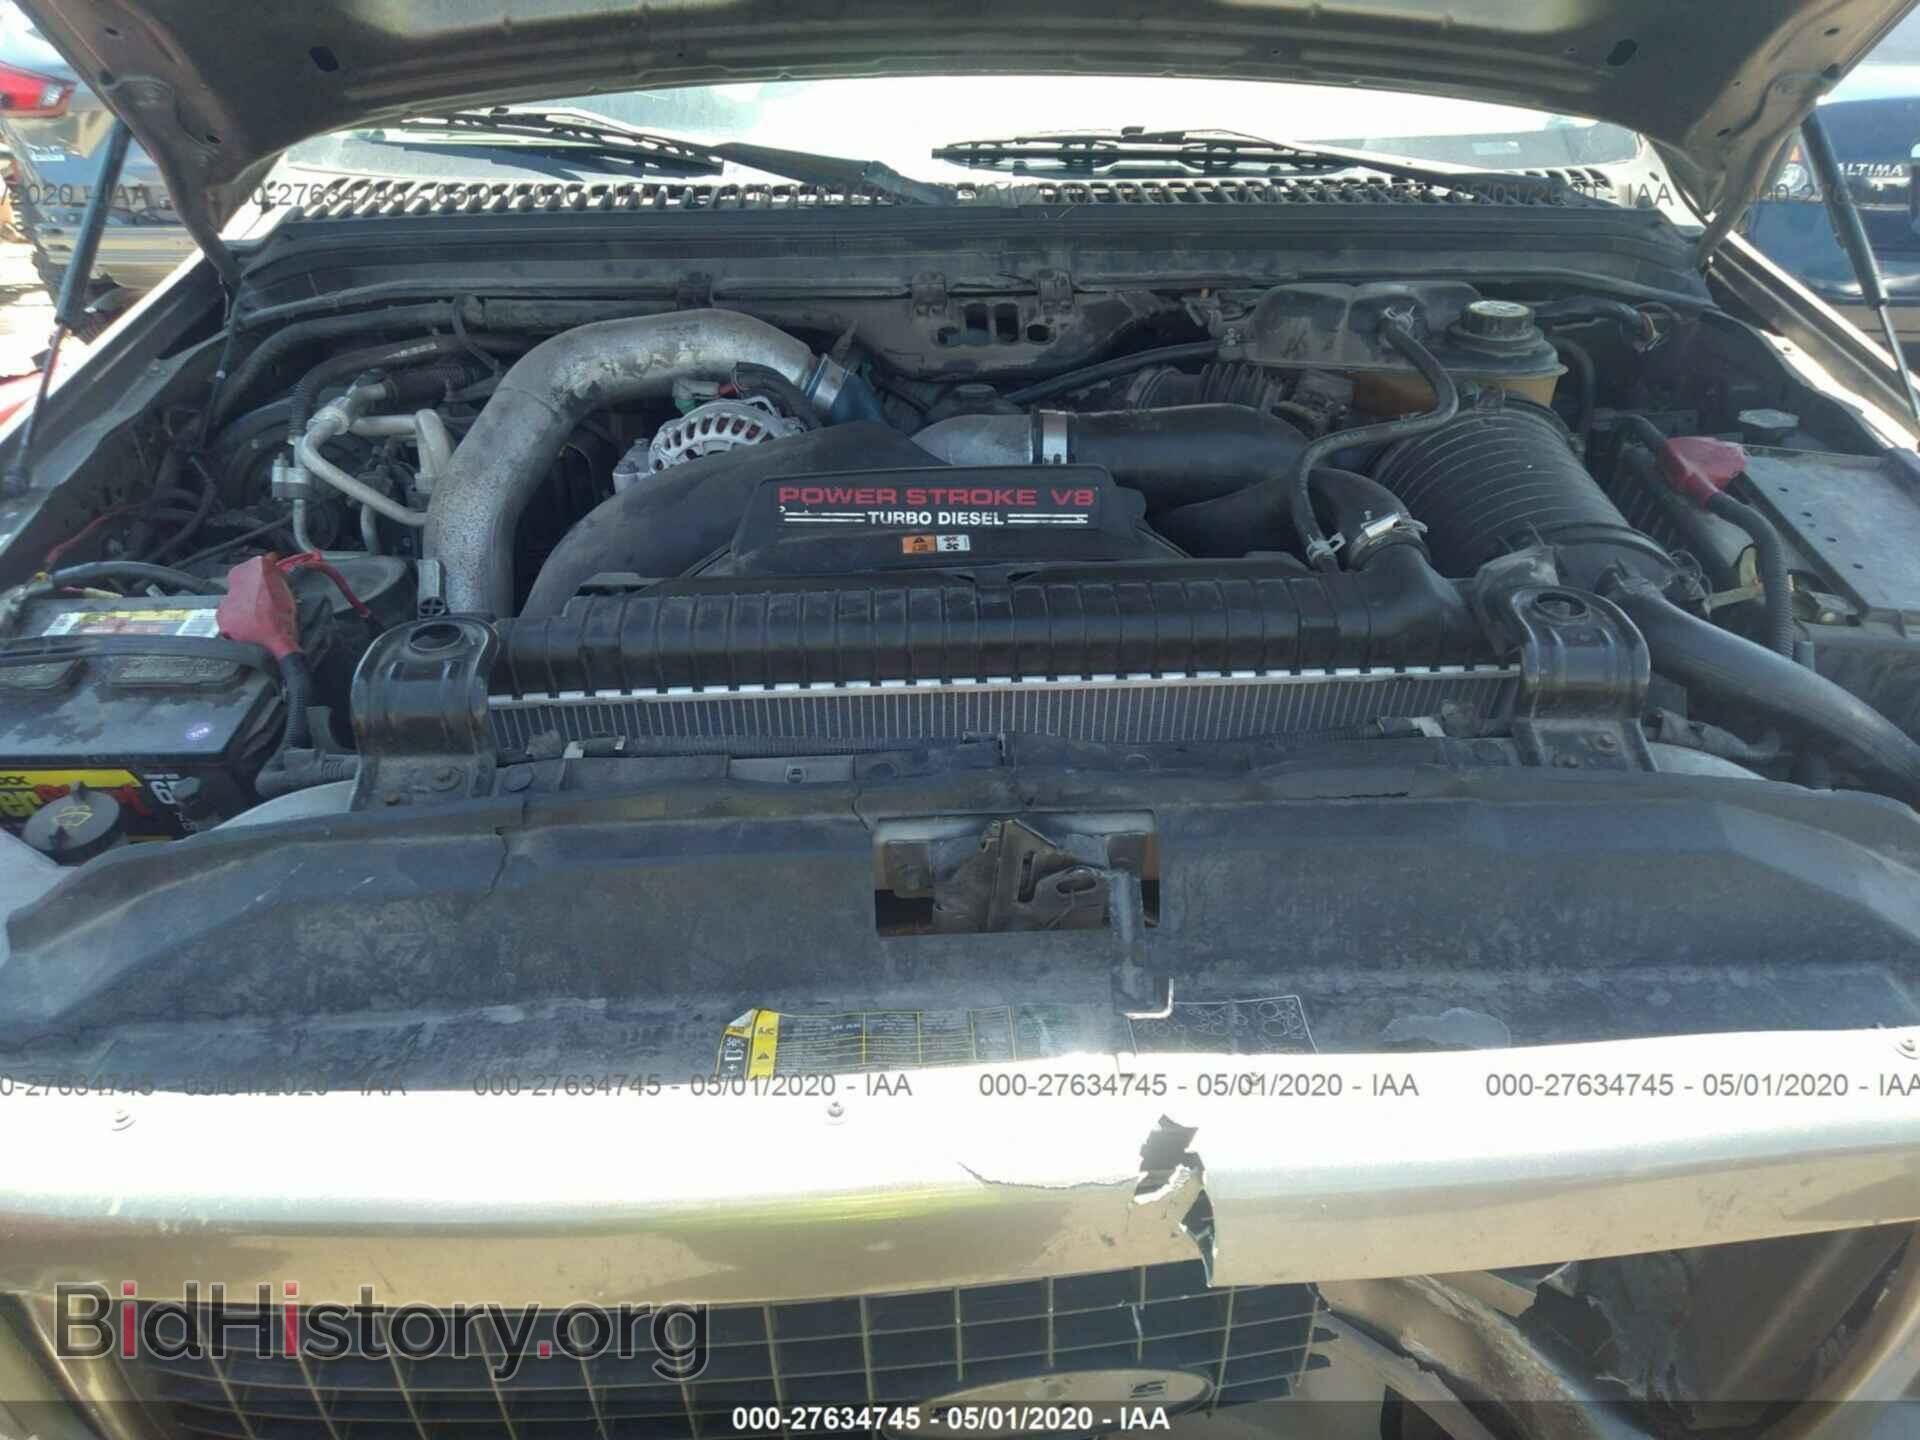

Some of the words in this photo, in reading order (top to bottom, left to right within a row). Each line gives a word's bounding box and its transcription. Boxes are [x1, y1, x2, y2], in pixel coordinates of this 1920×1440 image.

[779, 487, 896, 504] POWER
[906, 488, 1036, 506] STROKE
[1051, 489, 1094, 506] V8
[867, 511, 932, 525] TURBO
[938, 511, 1004, 526] DIESEL
